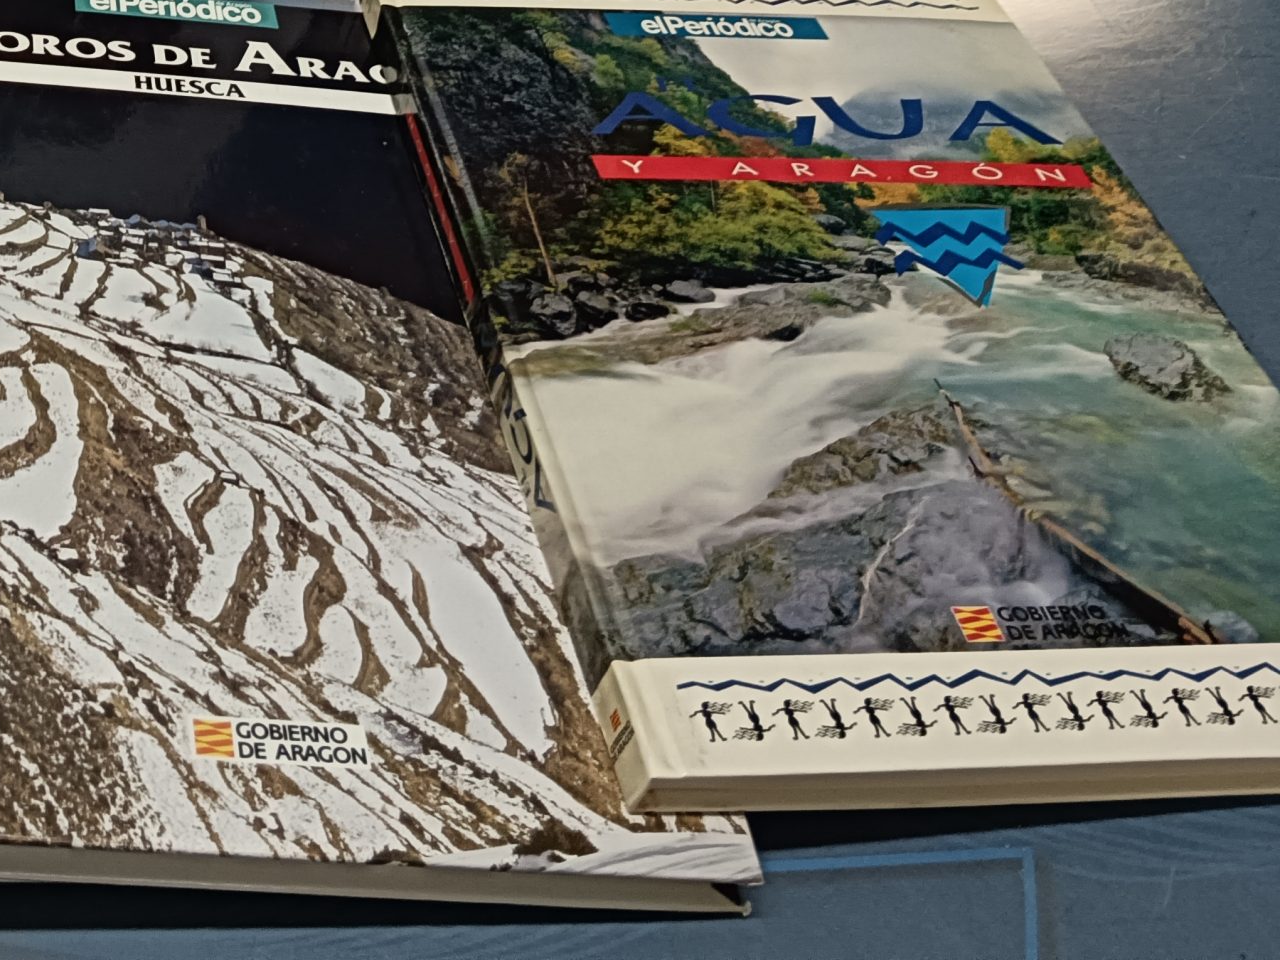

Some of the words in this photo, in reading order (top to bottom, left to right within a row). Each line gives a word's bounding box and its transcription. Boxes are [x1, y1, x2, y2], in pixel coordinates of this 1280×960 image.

[153, 44, 217, 70] DE
[134, 73, 246, 99] HUESCA
[593, 91, 1064, 146] AGUA
[621, 159, 644, 174] Y
[731, 161, 1067, 183] ARAGÓN
[996, 603, 1107, 623] GOBIERNO
[1006, 625, 1037, 641] DE
[235, 721, 348, 744] GOBIERNO
[237, 741, 268, 760] DE
[275, 743, 368, 765] ARAGON
